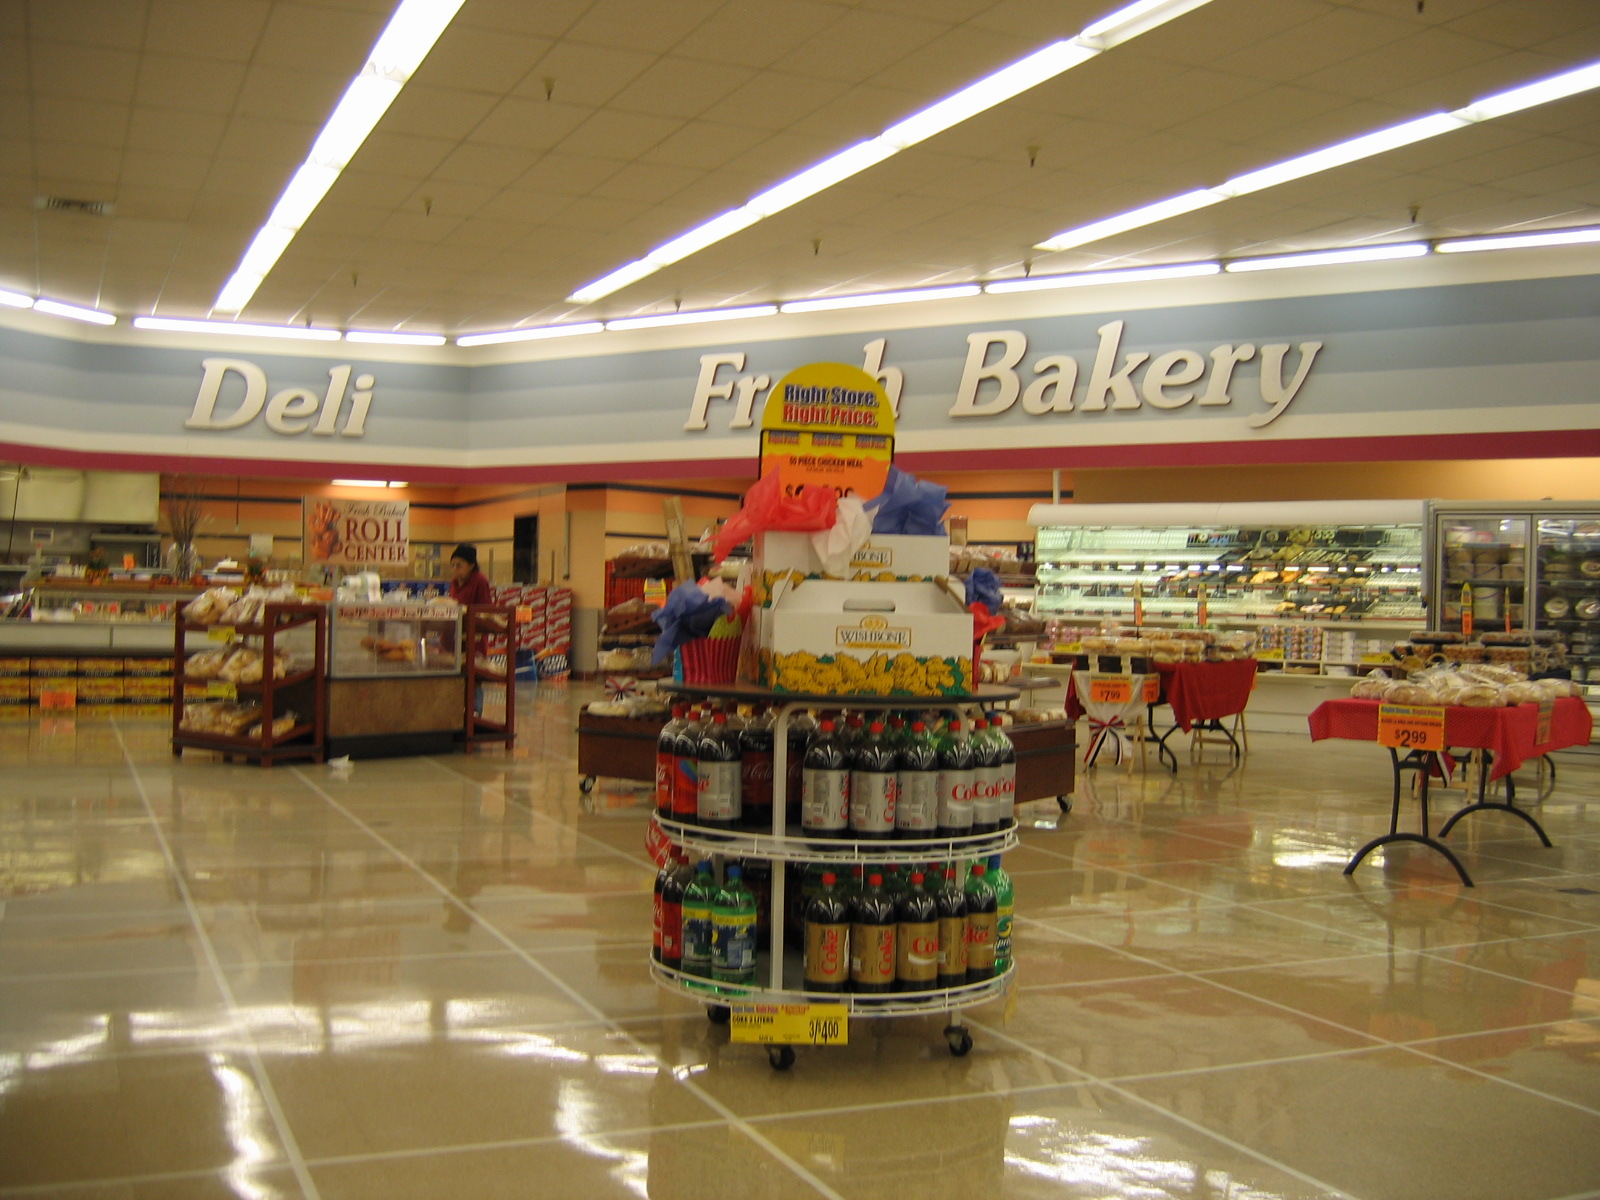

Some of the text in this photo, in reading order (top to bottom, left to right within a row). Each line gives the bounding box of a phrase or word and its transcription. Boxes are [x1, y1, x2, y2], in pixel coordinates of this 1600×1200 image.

[684, 319, 1324, 432] Frh Bakery
[184, 357, 375, 438] Deli
[785, 384, 880, 408] Right Store.
[783, 404, 879, 428] Right Price.
[345, 518, 408, 544] ROLL
[344, 546, 406, 563] CENTER
[841, 630, 908, 644] WISHBONE
[822, 929, 838, 976] Coke
[879, 930, 894, 976] Coke
